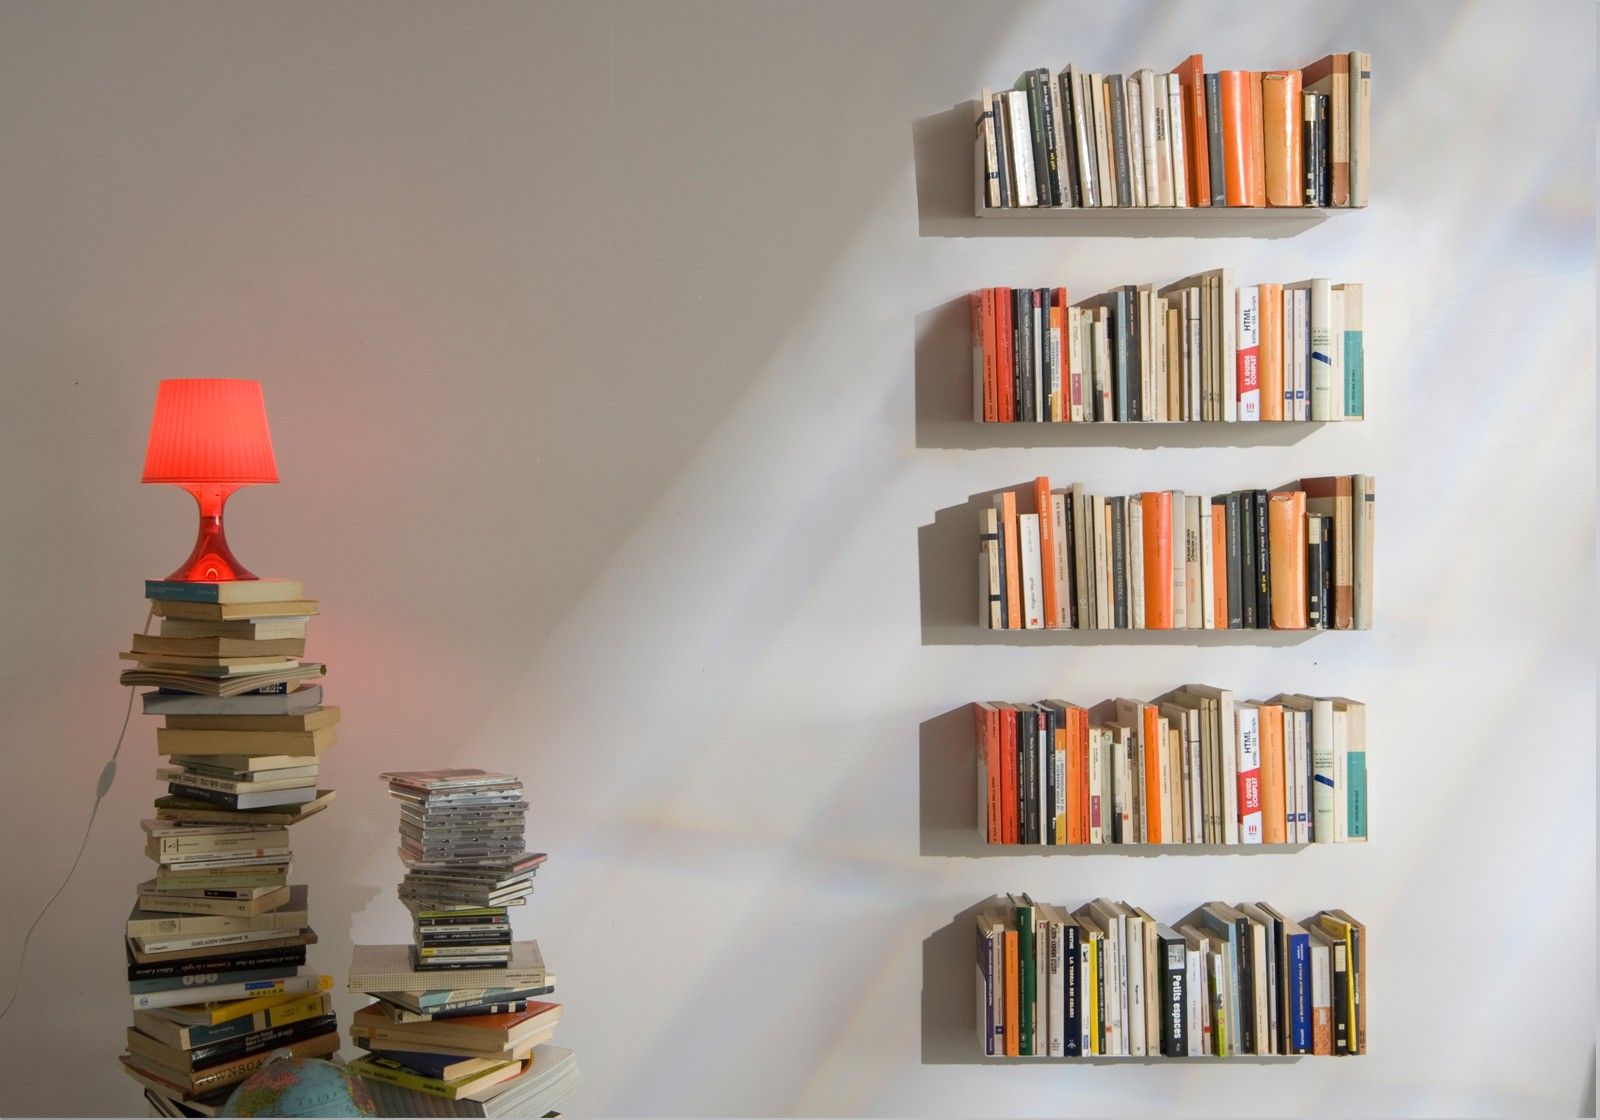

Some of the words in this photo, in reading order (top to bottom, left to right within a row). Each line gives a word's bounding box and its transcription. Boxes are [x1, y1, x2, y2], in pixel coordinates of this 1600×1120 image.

[1243, 308, 1251, 331] HTML
[1244, 730, 1252, 754] HTML
[1069, 956, 1074, 964] LA
[249, 988, 284, 996] DESIGN
[1172, 975, 1182, 1001] Petits
[445, 1002, 457, 1010] Arte
[1171, 1003, 1181, 1039] espaces
[199, 1061, 263, 1087] TOWNSCA
